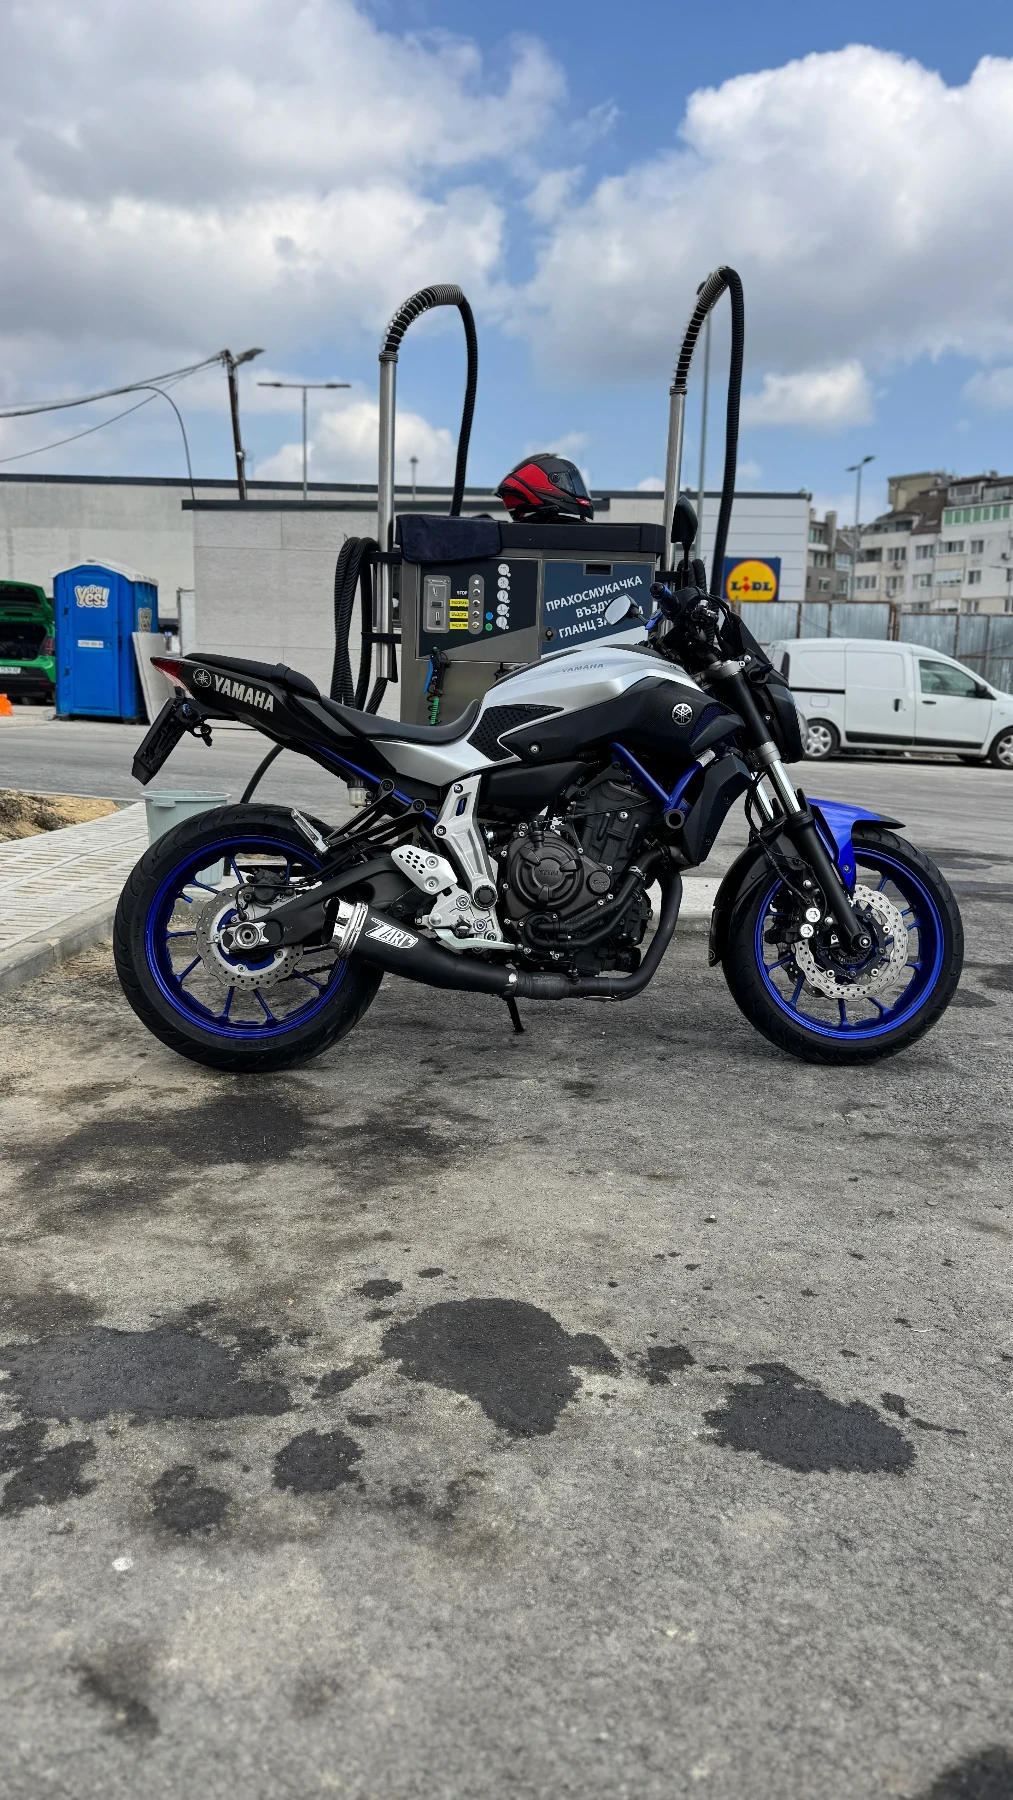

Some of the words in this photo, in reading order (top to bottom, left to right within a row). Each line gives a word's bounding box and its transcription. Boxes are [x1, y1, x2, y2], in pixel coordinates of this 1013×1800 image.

[545, 575, 643, 612] ПРАХОСМУКАЧКА
[559, 620, 597, 638] ГЛАНЦ
[562, 664, 604, 673] YAMAHA
[213, 674, 274, 712] YAMAHA
